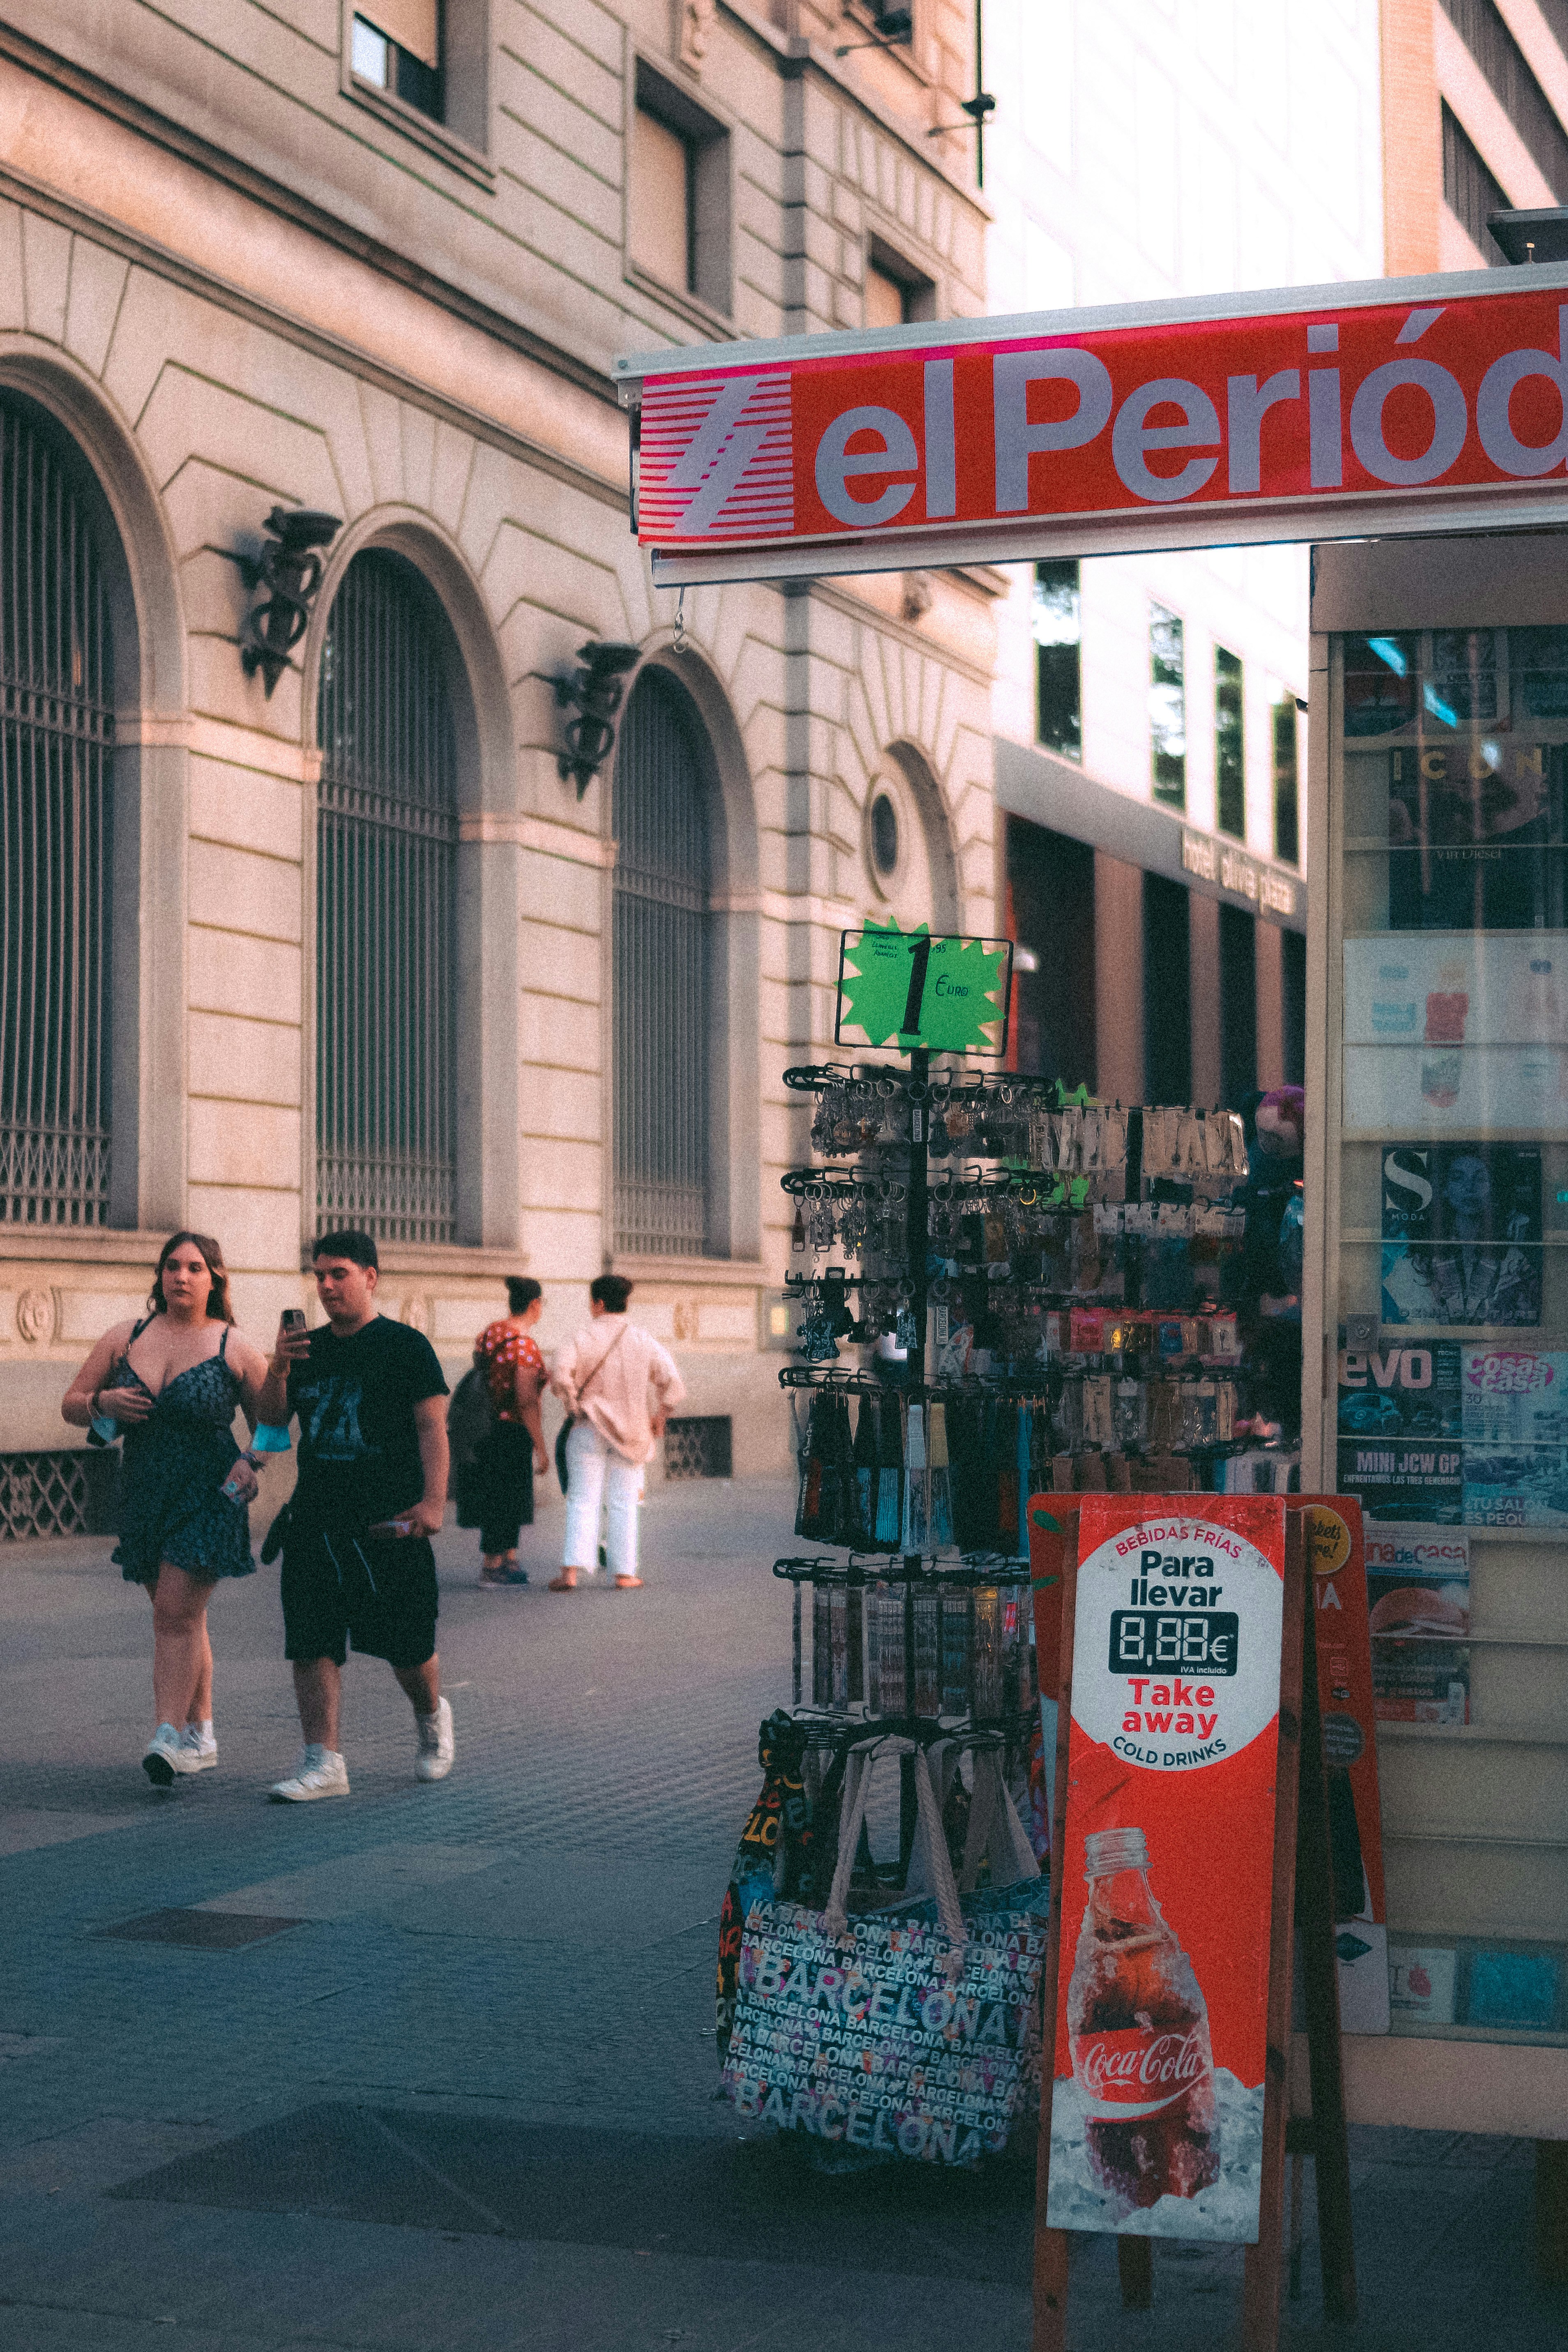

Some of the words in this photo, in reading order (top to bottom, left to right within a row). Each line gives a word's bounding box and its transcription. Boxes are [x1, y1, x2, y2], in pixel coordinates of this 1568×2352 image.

[815, 358, 956, 527] el
[1384, 1152, 1433, 1211] S
[1392, 1213, 1425, 1222] MODA
[1357, 1452, 1395, 1472] MINI
[1399, 1453, 1435, 1473] JCW
[1439, 1454, 1460, 1473] GP
[1115, 1526, 1189, 1556] BEBIDAS
[1194, 1528, 1242, 1559] FRÍAS
[1414, 1545, 1467, 1563] casa
[1140, 1550, 1214, 1578] Para
[1130, 1579, 1223, 1607] llevar
[1128, 1678, 1215, 1706] Take
[1122, 1710, 1218, 1741] away
[1113, 1736, 1158, 1764] COLD
[1163, 1738, 1227, 1767] DRINKS
[741, 1932, 835, 1967] BARCELONA
[842, 1956, 938, 1990] BARCELONA
[755, 1954, 1007, 2045] BARCELONA
[747, 1992, 841, 2027] BARCELONA
[846, 2014, 945, 2050] BARCELONA
[755, 2028, 863, 2068] BARCELONA
[815, 2080, 913, 2113] BARCELONA
